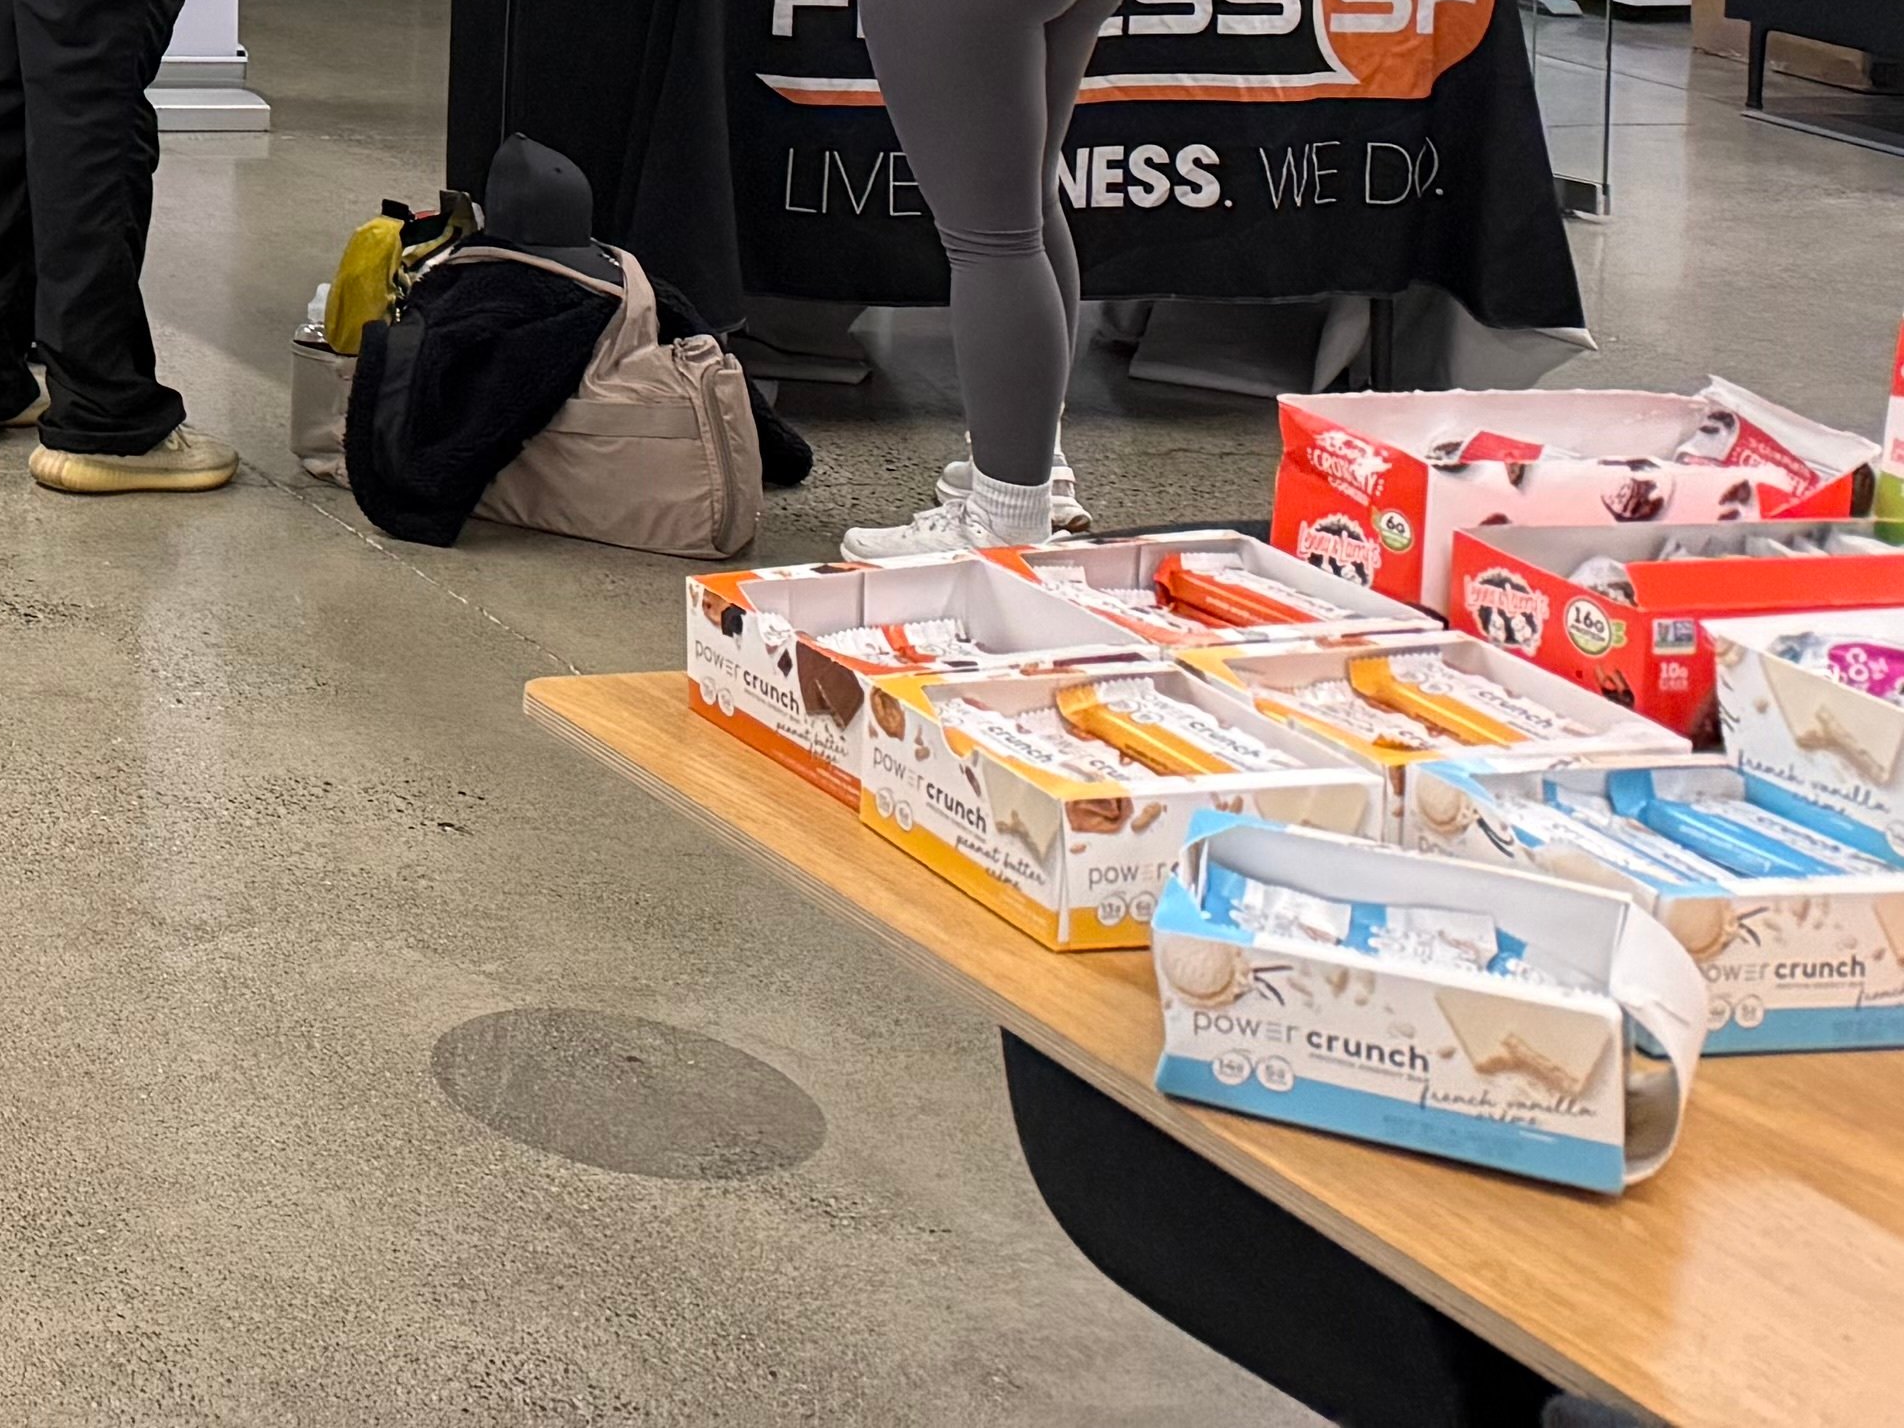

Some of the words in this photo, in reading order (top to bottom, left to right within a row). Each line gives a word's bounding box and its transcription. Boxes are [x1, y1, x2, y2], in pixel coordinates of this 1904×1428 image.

[1056, 144, 1234, 210] NESS.
[1259, 141, 1342, 210] WE
[743, 670, 801, 716] crunch
[987, 722, 1055, 764] crunch
[1188, 719, 1265, 761] crunch
[873, 746, 925, 792] power
[926, 782, 988, 834] crunch
[1088, 863, 1166, 890] power
[1705, 962, 1771, 984] ower
[1774, 954, 1866, 980] crunch
[1193, 1010, 1300, 1044] power
[1306, 1030, 1430, 1074] crunch
[1420, 1082, 1499, 1111] french
[1506, 1095, 1598, 1118] vanilla
